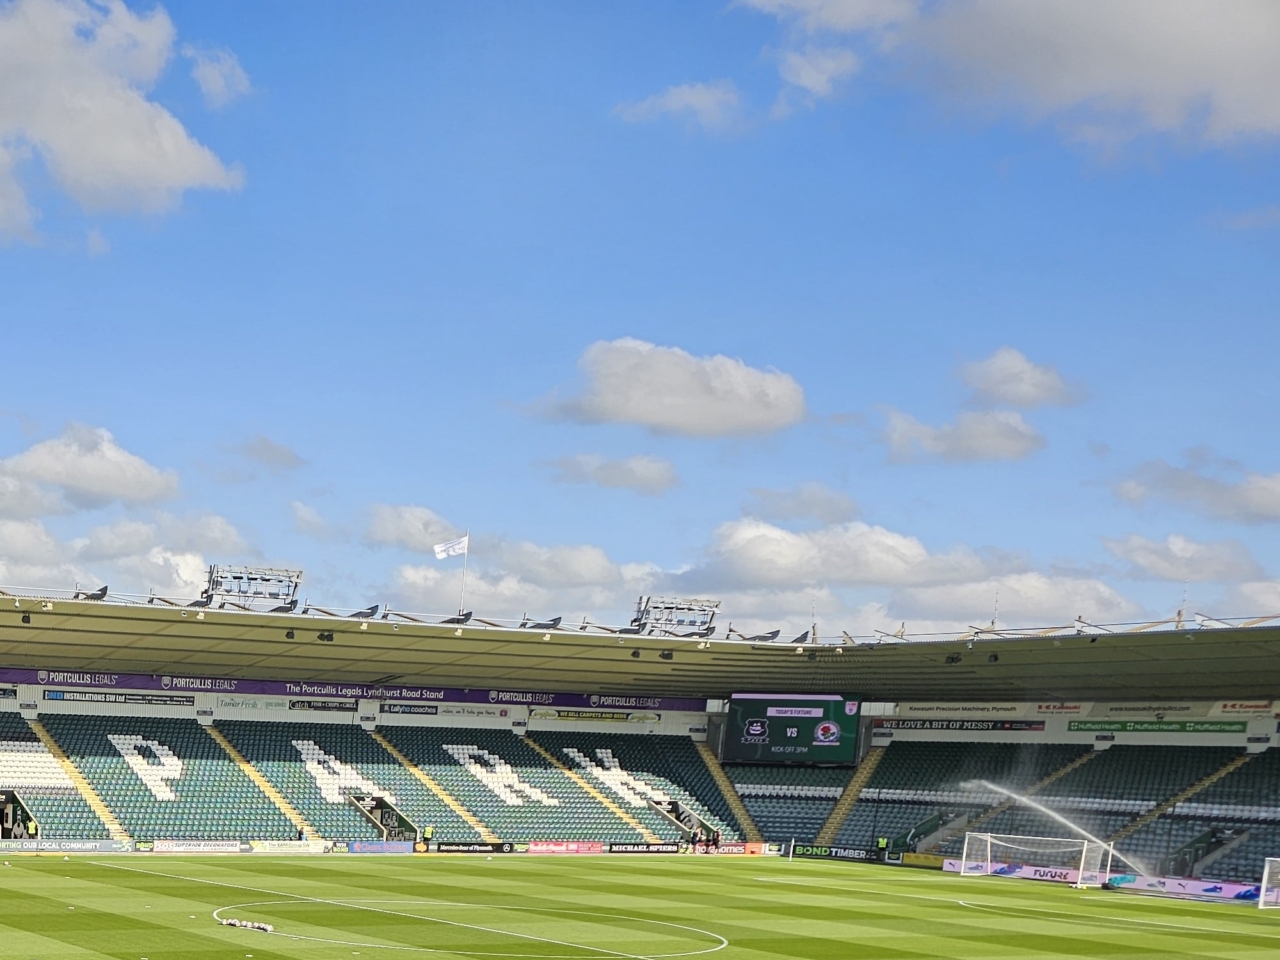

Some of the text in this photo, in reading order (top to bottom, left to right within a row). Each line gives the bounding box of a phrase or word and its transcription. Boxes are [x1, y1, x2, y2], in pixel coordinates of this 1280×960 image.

[49, 672, 91, 684] PORTCULLIS
[173, 677, 212, 689] PORTCULLIS
[286, 683, 444, 699] The Portcullis Legals Lyndhurst Road Stand
[64, 692, 105, 702] INSTALLATIONS
[105, 694, 115, 702] SW
[498, 691, 532, 702] PORTCULLIS
[601, 695, 636, 706] PORTCULLIS
[390, 705, 410, 714] tallyho
[883, 720, 994, 730] WE LOVE A BIT OF MESSY
[786, 728, 798, 737] VS
[23, 841, 36, 849] OUR
[611, 844, 677, 852] MICHAEL SPIERS
[796, 846, 829, 856] BOND
[830, 847, 866, 859] TIMBER
